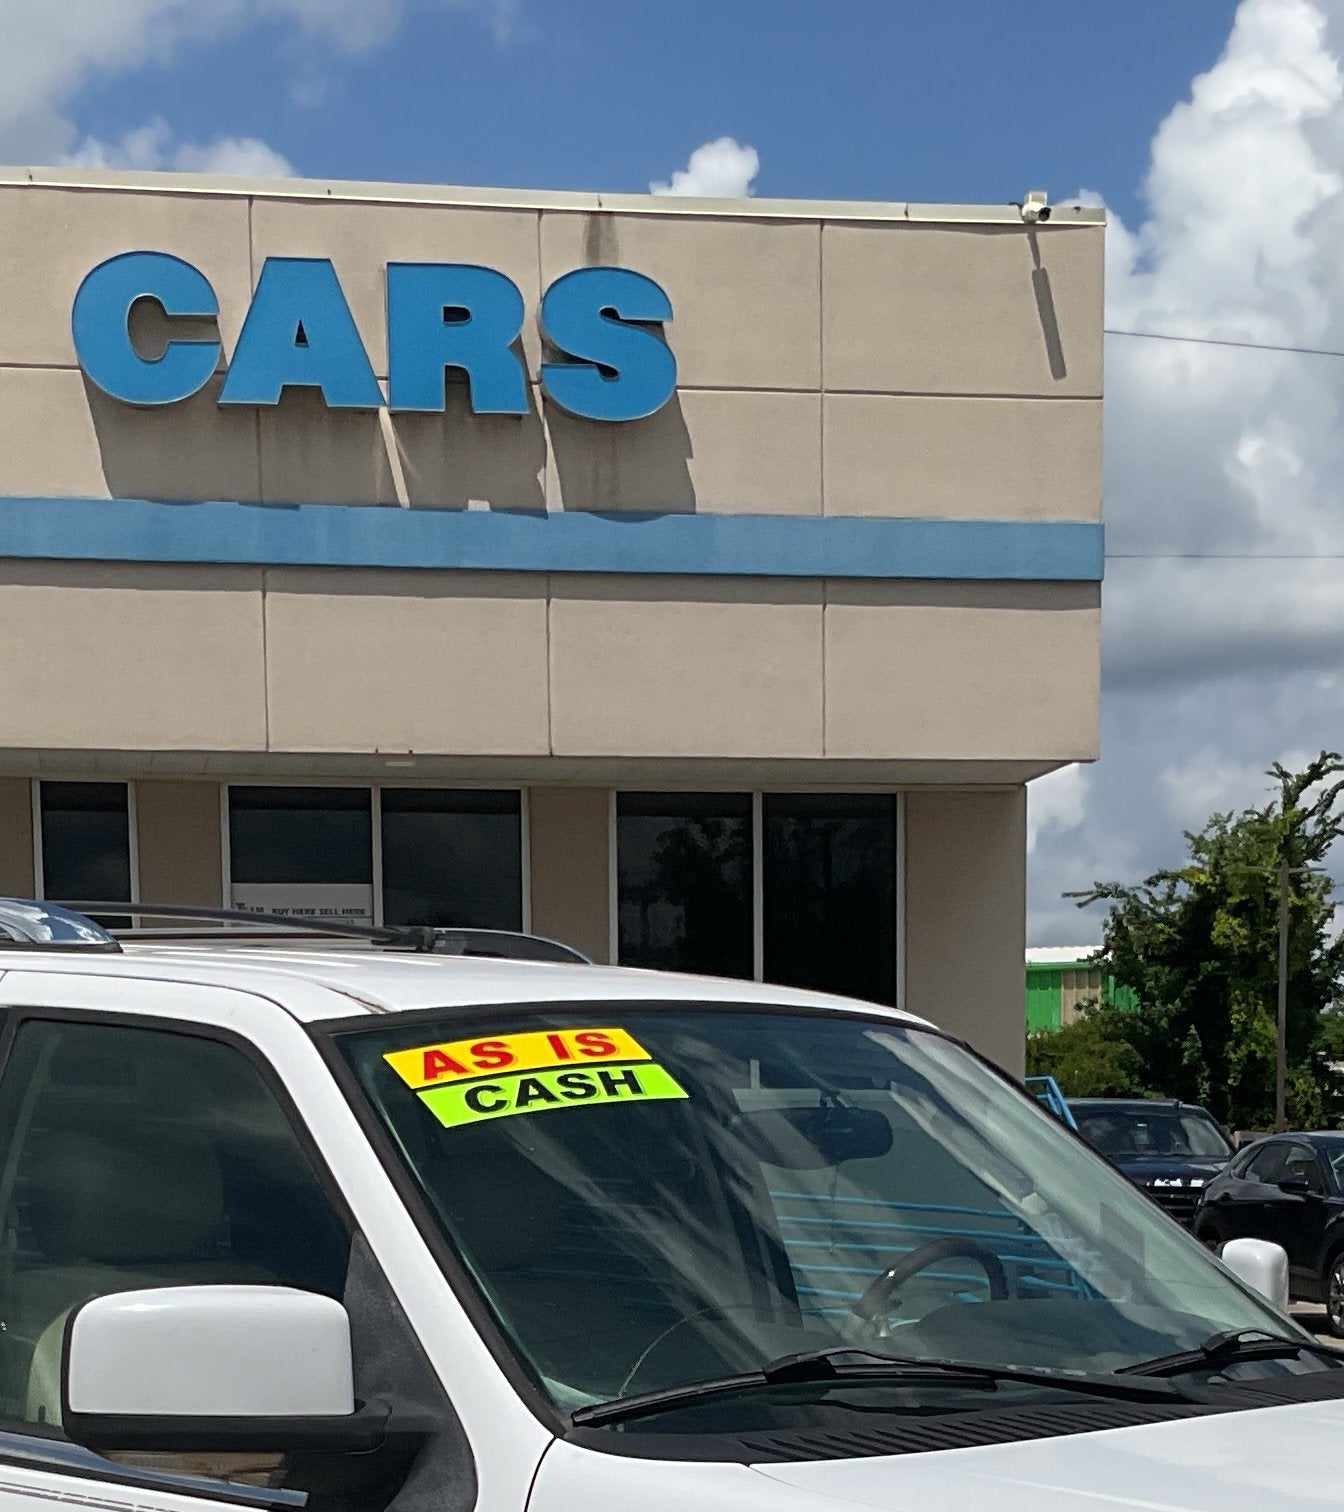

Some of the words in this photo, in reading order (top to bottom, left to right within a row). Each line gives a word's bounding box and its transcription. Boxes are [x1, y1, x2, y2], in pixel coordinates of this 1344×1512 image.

[70, 250, 679, 421] CARS
[422, 1041, 517, 1081] AS
[546, 1032, 620, 1060] IS
[463, 1069, 644, 1114] CASH
